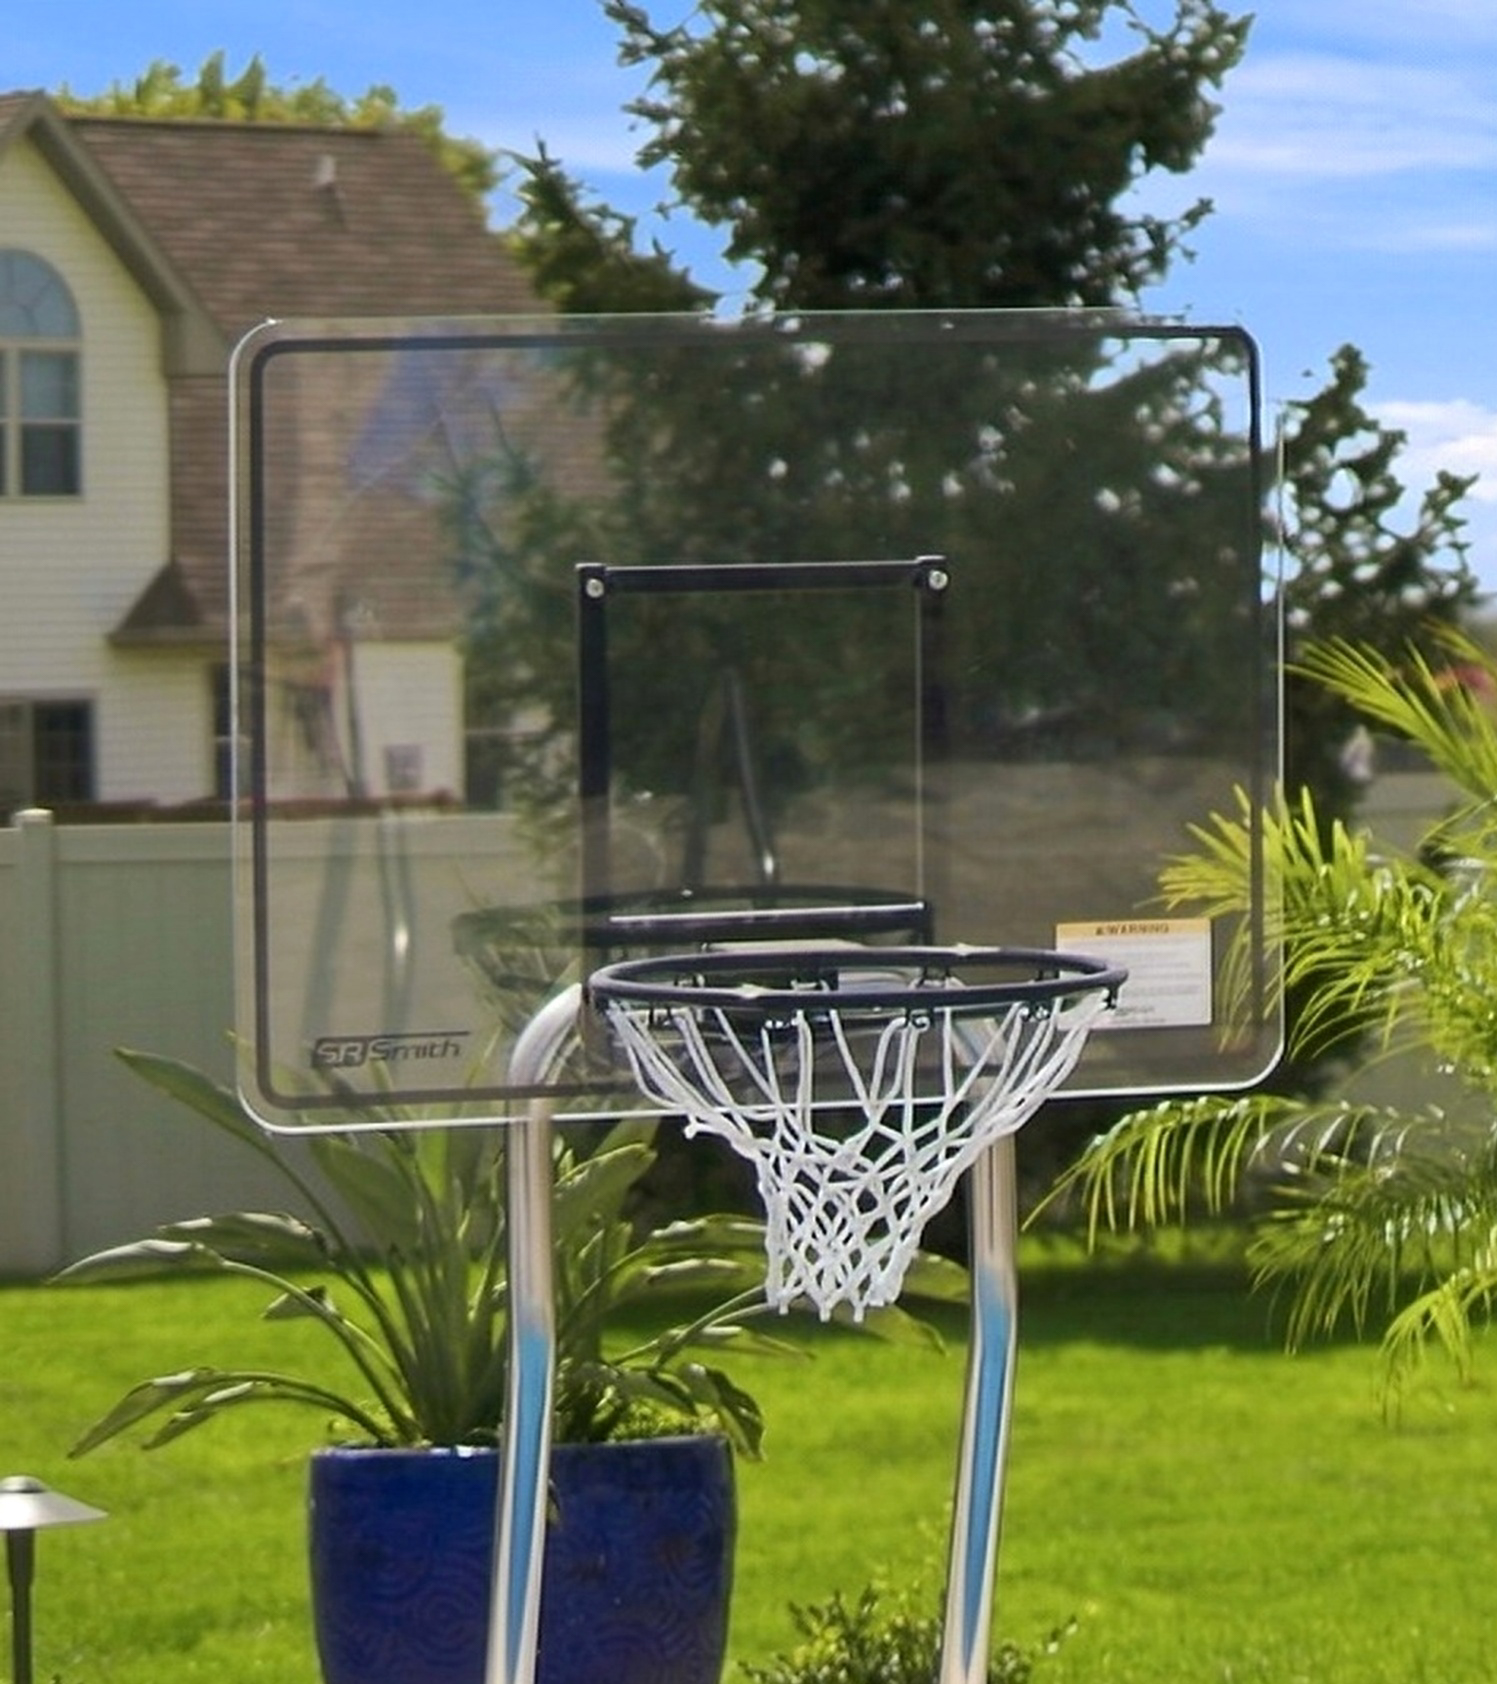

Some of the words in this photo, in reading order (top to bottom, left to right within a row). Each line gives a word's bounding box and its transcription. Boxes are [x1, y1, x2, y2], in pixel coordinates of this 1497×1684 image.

[1106, 923, 1170, 935] WARNING
[314, 1039, 366, 1065] SR
[368, 1038, 460, 1060] Smith
